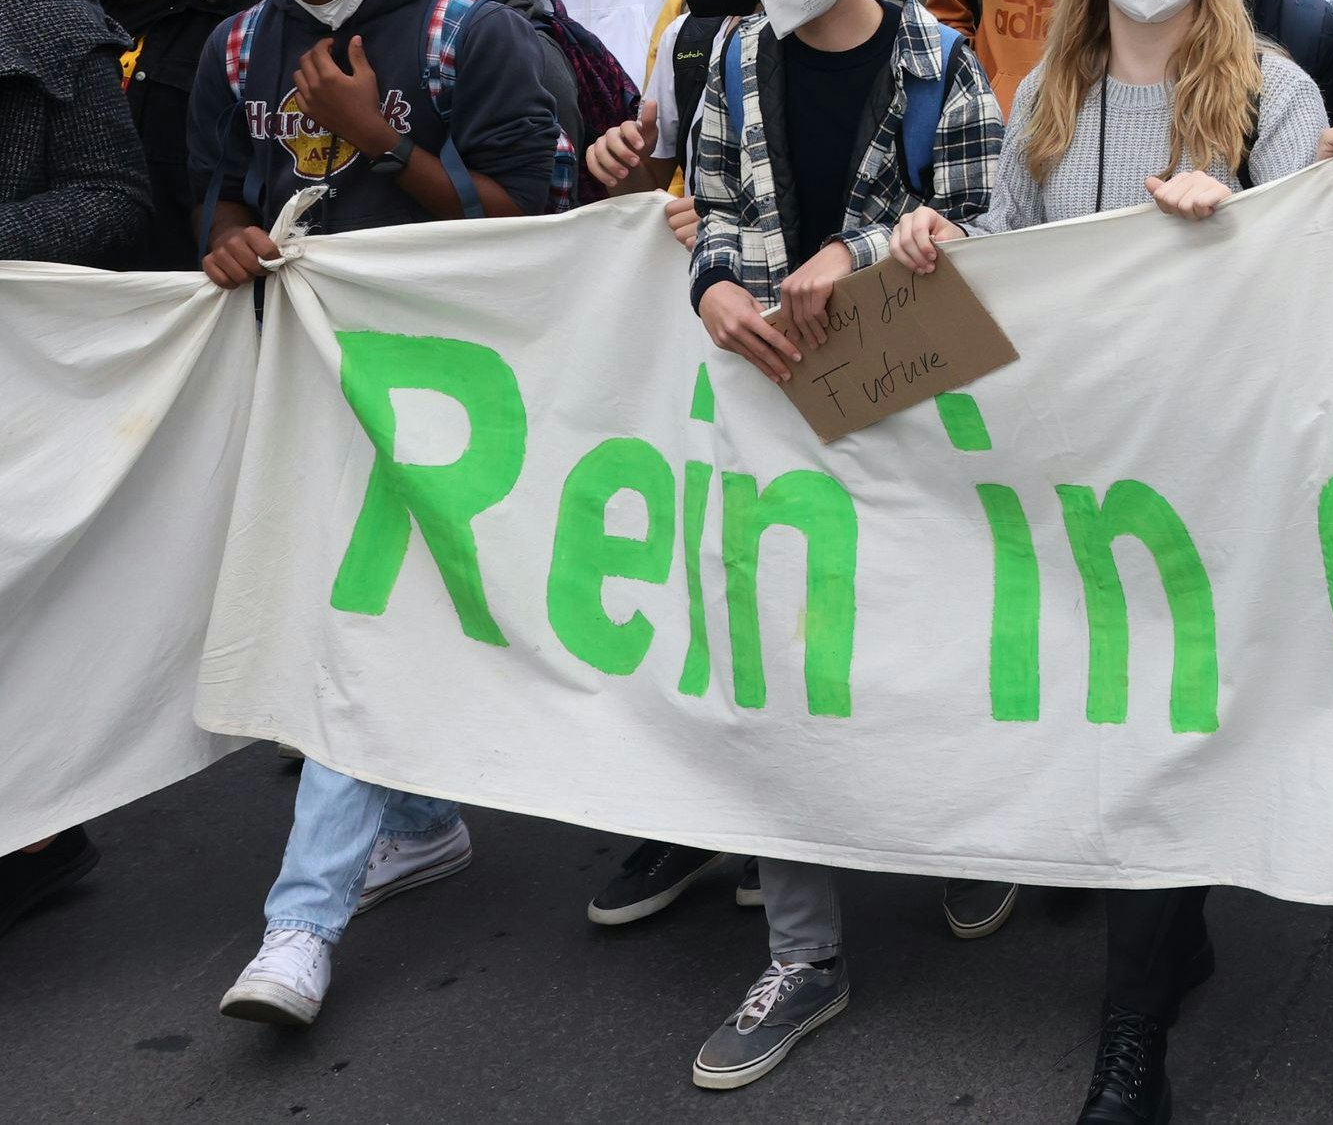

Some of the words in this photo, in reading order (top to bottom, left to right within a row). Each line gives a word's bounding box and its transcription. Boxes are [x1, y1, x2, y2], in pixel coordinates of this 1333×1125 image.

[995, 5, 1049, 41] adi
[812, 351, 948, 417] Future
[329, 330, 857, 718] Rein
[933, 392, 1219, 734] in
